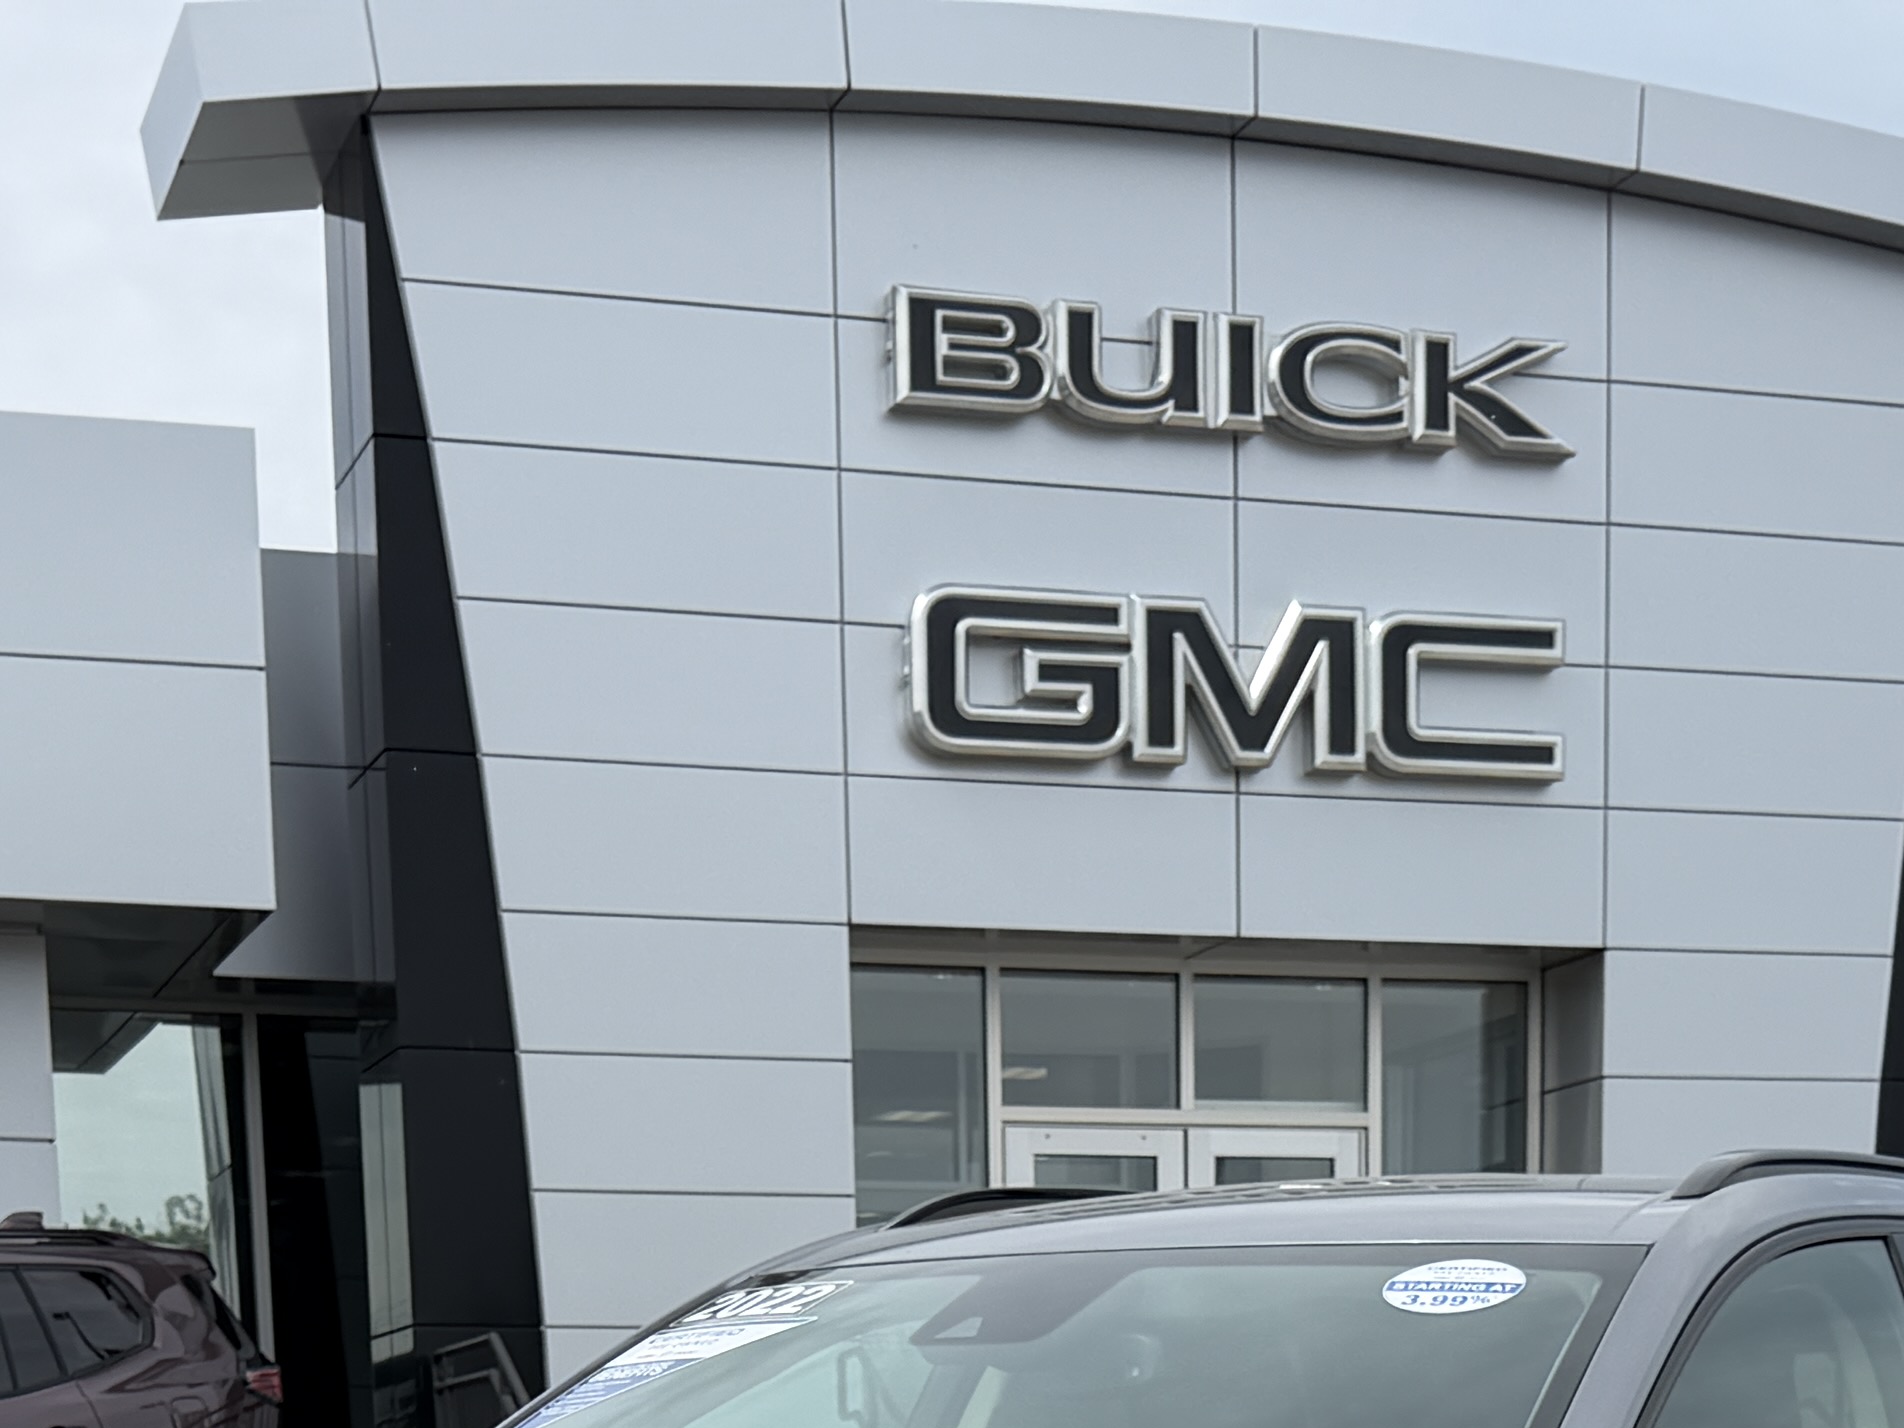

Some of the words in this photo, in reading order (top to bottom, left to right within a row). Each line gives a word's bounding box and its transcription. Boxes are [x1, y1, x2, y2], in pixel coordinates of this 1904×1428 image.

[886, 284, 1576, 460] BUICK
[906, 583, 1565, 782] GMC
[682, 1284, 837, 1323] 2022
[1393, 1282, 1485, 1293] STARTING
[1489, 1284, 1517, 1293] AT
